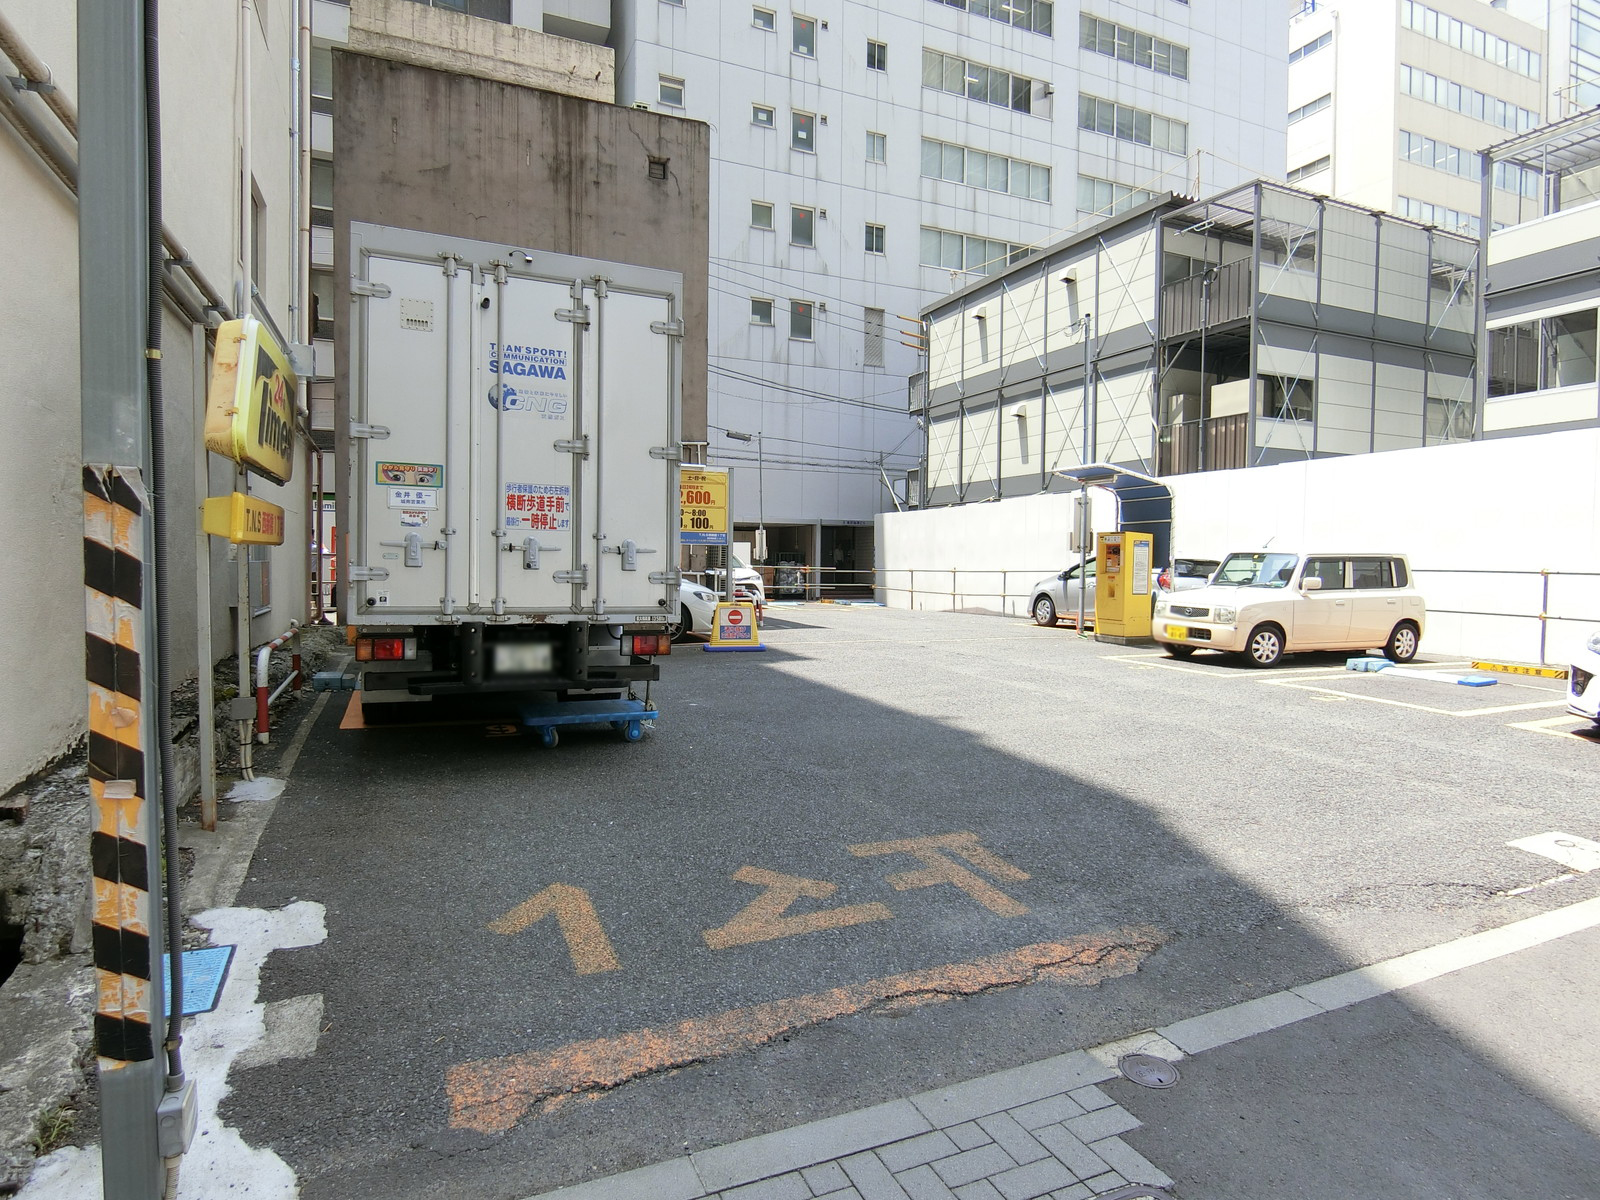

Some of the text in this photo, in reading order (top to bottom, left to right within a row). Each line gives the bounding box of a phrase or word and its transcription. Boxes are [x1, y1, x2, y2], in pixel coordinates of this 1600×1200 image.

[490, 352, 565, 365] CMMUNICATION
[489, 360, 566, 380] SAGAWA
[256, 344, 296, 463] Times
[506, 395, 568, 414] CNG
[507, 494, 569, 513] 横断歩道手前で
[1502, 665, 1542, 676] 高さ注意
